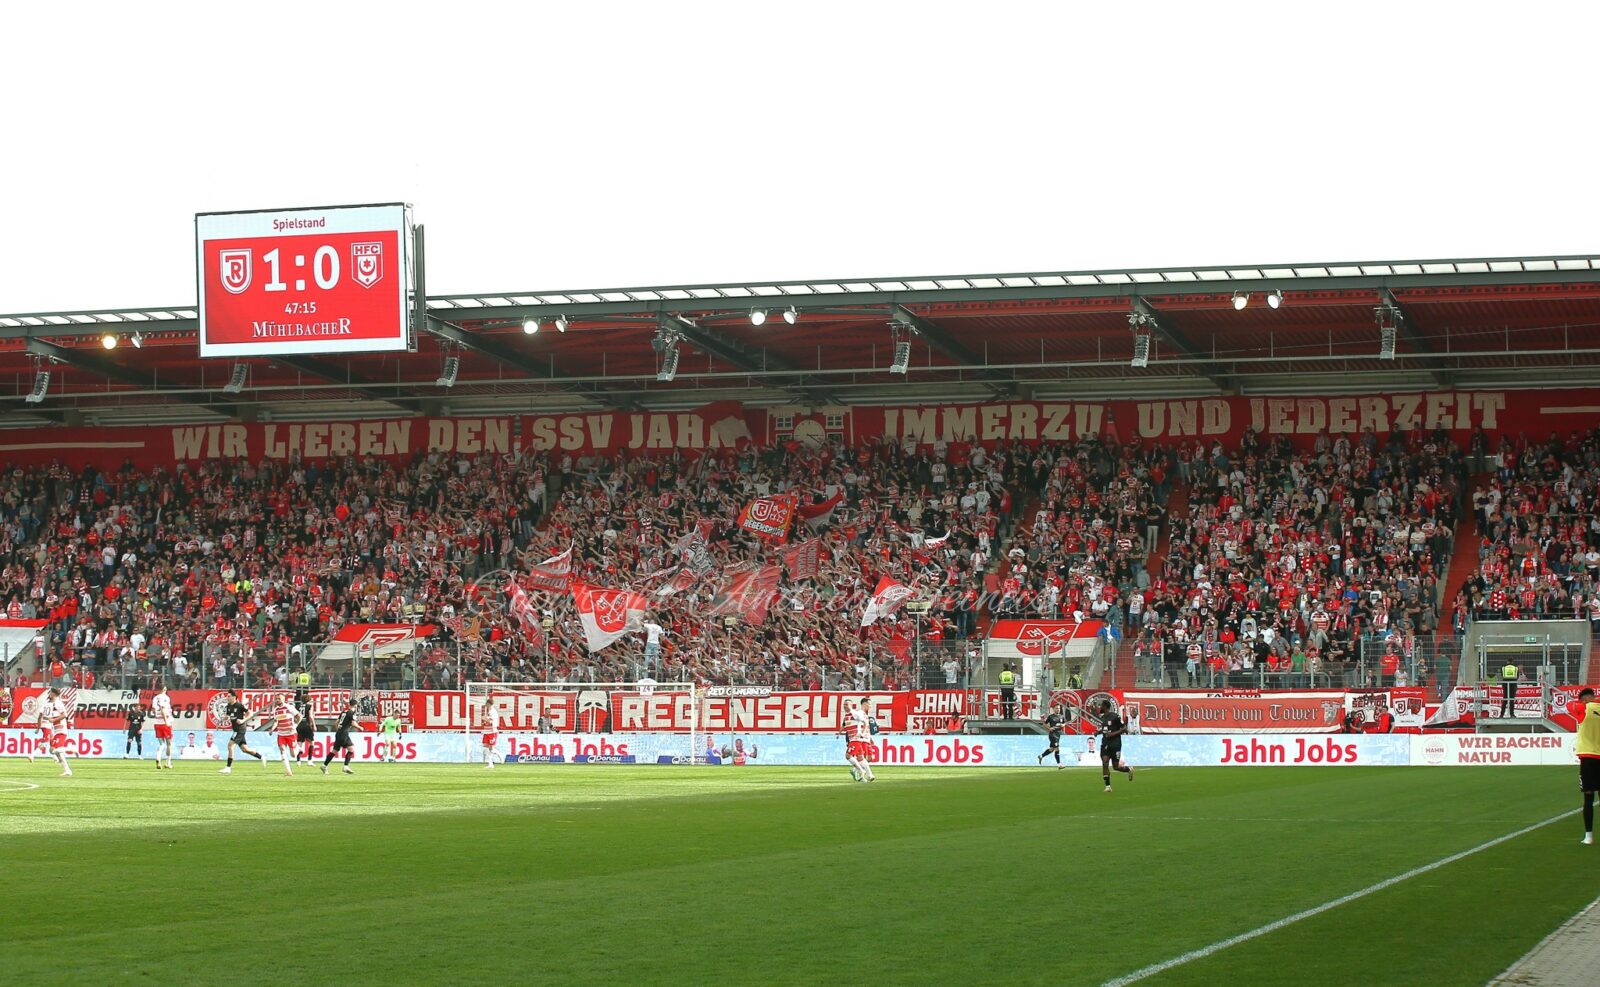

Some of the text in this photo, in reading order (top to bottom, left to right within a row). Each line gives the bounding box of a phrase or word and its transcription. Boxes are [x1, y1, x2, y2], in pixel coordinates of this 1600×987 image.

[273, 216, 326, 232] Spielstand
[355, 245, 379, 256] HFC
[262, 245, 341, 292] 1:0
[284, 301, 317, 314] 47:15
[252, 317, 352, 338] MÜHLBACHER
[172, 424, 248, 461] WIR
[264, 420, 411, 459] LIEBEN
[428, 419, 510, 455] DEN
[533, 413, 613, 450] SSV
[884, 403, 1104, 445] IMMERZU
[1137, 400, 1231, 438] UND
[1250, 393, 1506, 435] JEDERZEIT
[184, 703, 203, 719] 81
[380, 700, 410, 717] 1889
[425, 695, 568, 728] ULTRAS
[914, 693, 963, 713] JAHN
[1145, 703, 1318, 724] Die Power vom Tower
[870, 739, 984, 764] ahn Jobs
[1221, 738, 1358, 763] Jahn Jobs
[1458, 737, 1562, 748] WIR BACKEN
[1458, 751, 1512, 763] NATUR
